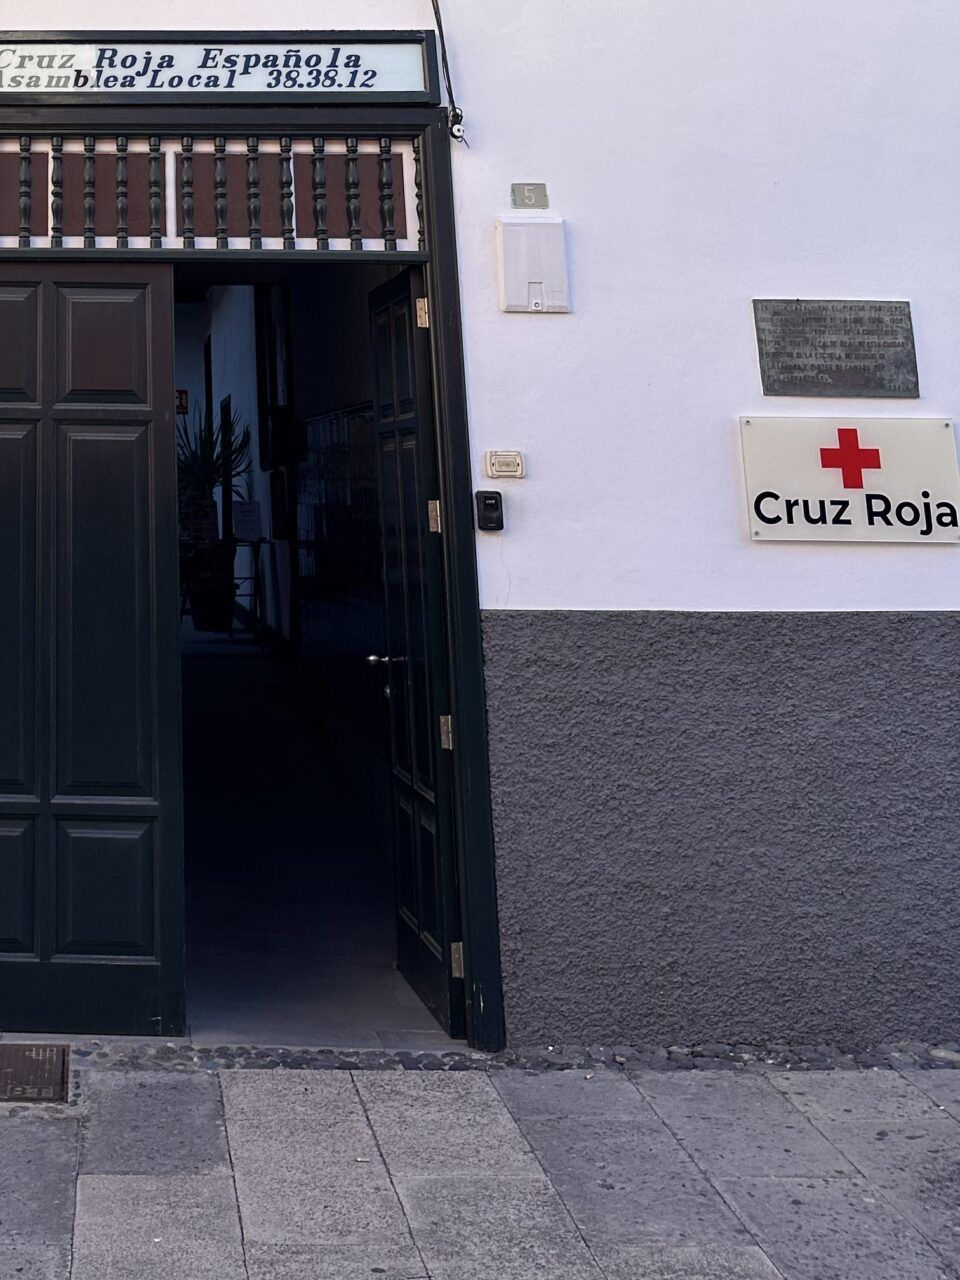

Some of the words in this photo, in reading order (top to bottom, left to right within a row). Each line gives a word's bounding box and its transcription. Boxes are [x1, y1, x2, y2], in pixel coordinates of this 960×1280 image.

[93, 48, 175, 77] Roja
[197, 48, 362, 75] Española
[146, 69, 236, 88] Local
[266, 69, 377, 89] 38.38.12
[524, 186, 535, 205] 5
[753, 491, 852, 525] Cruz
[865, 490, 959, 536] Roja
